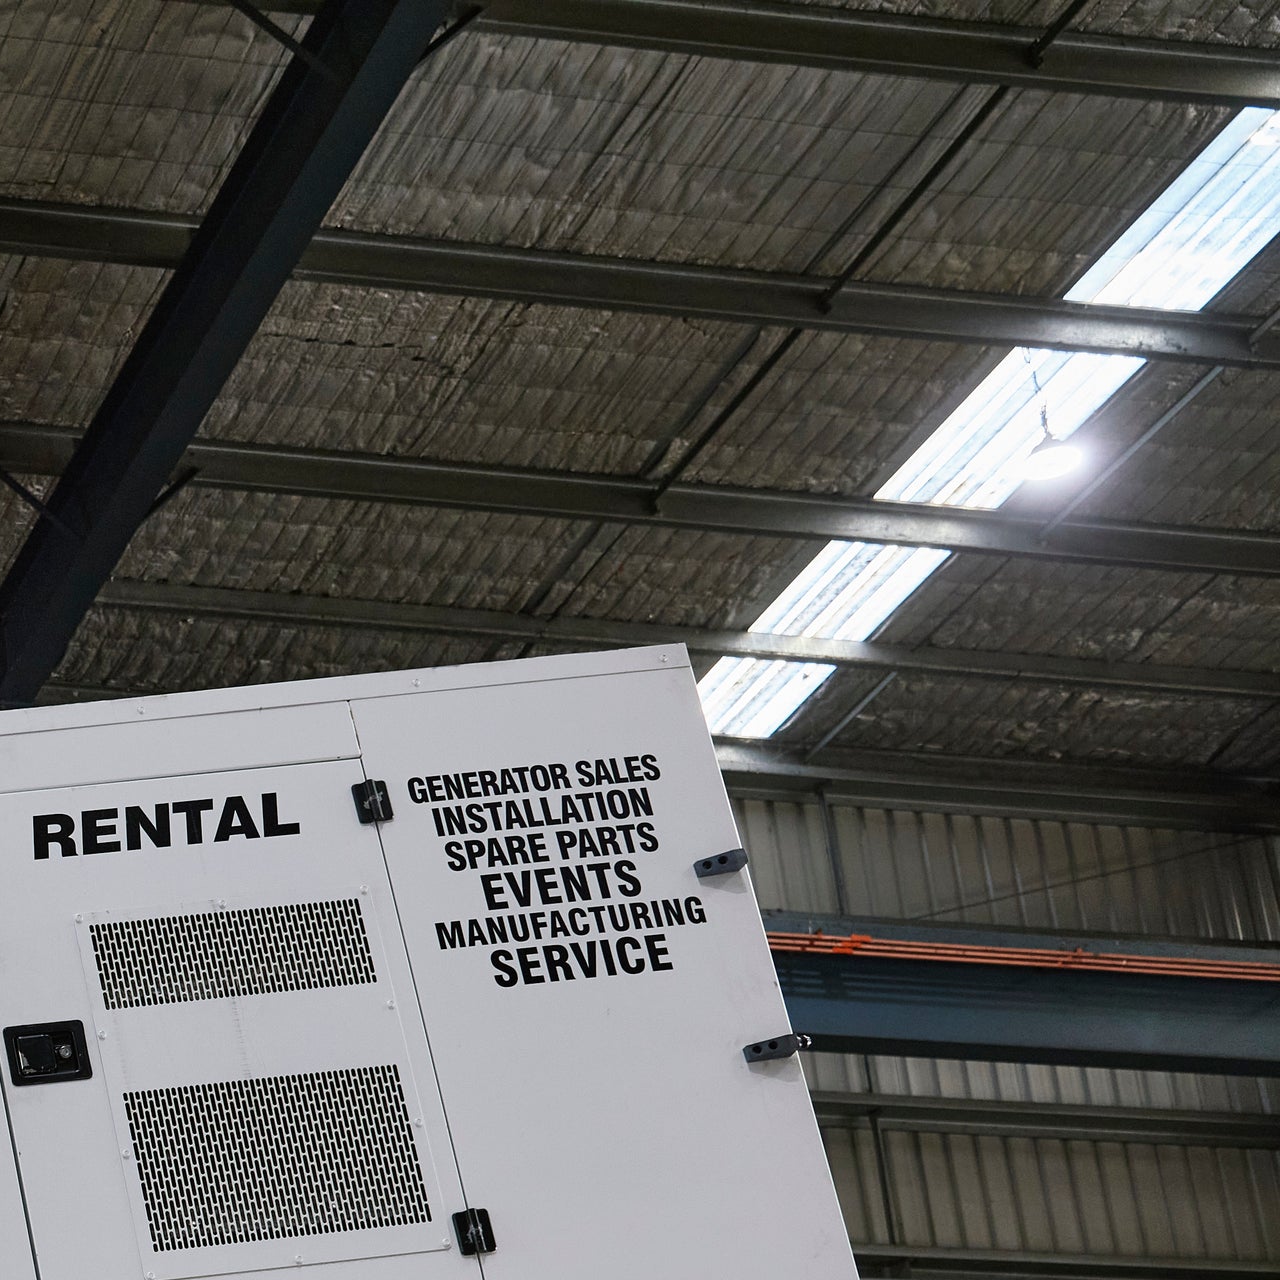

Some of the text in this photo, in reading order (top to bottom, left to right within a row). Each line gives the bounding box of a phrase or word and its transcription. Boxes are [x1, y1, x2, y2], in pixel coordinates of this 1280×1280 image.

[407, 754, 661, 805] GENERATOR SALES
[32, 792, 301, 860] RENTAL
[431, 787, 654, 837] INSTALLATION
[444, 822, 659, 872] SPARE PARTS
[480, 860, 642, 911] EVENTS
[434, 896, 707, 950] MANUFACTURING
[490, 934, 674, 988] SERVICE
